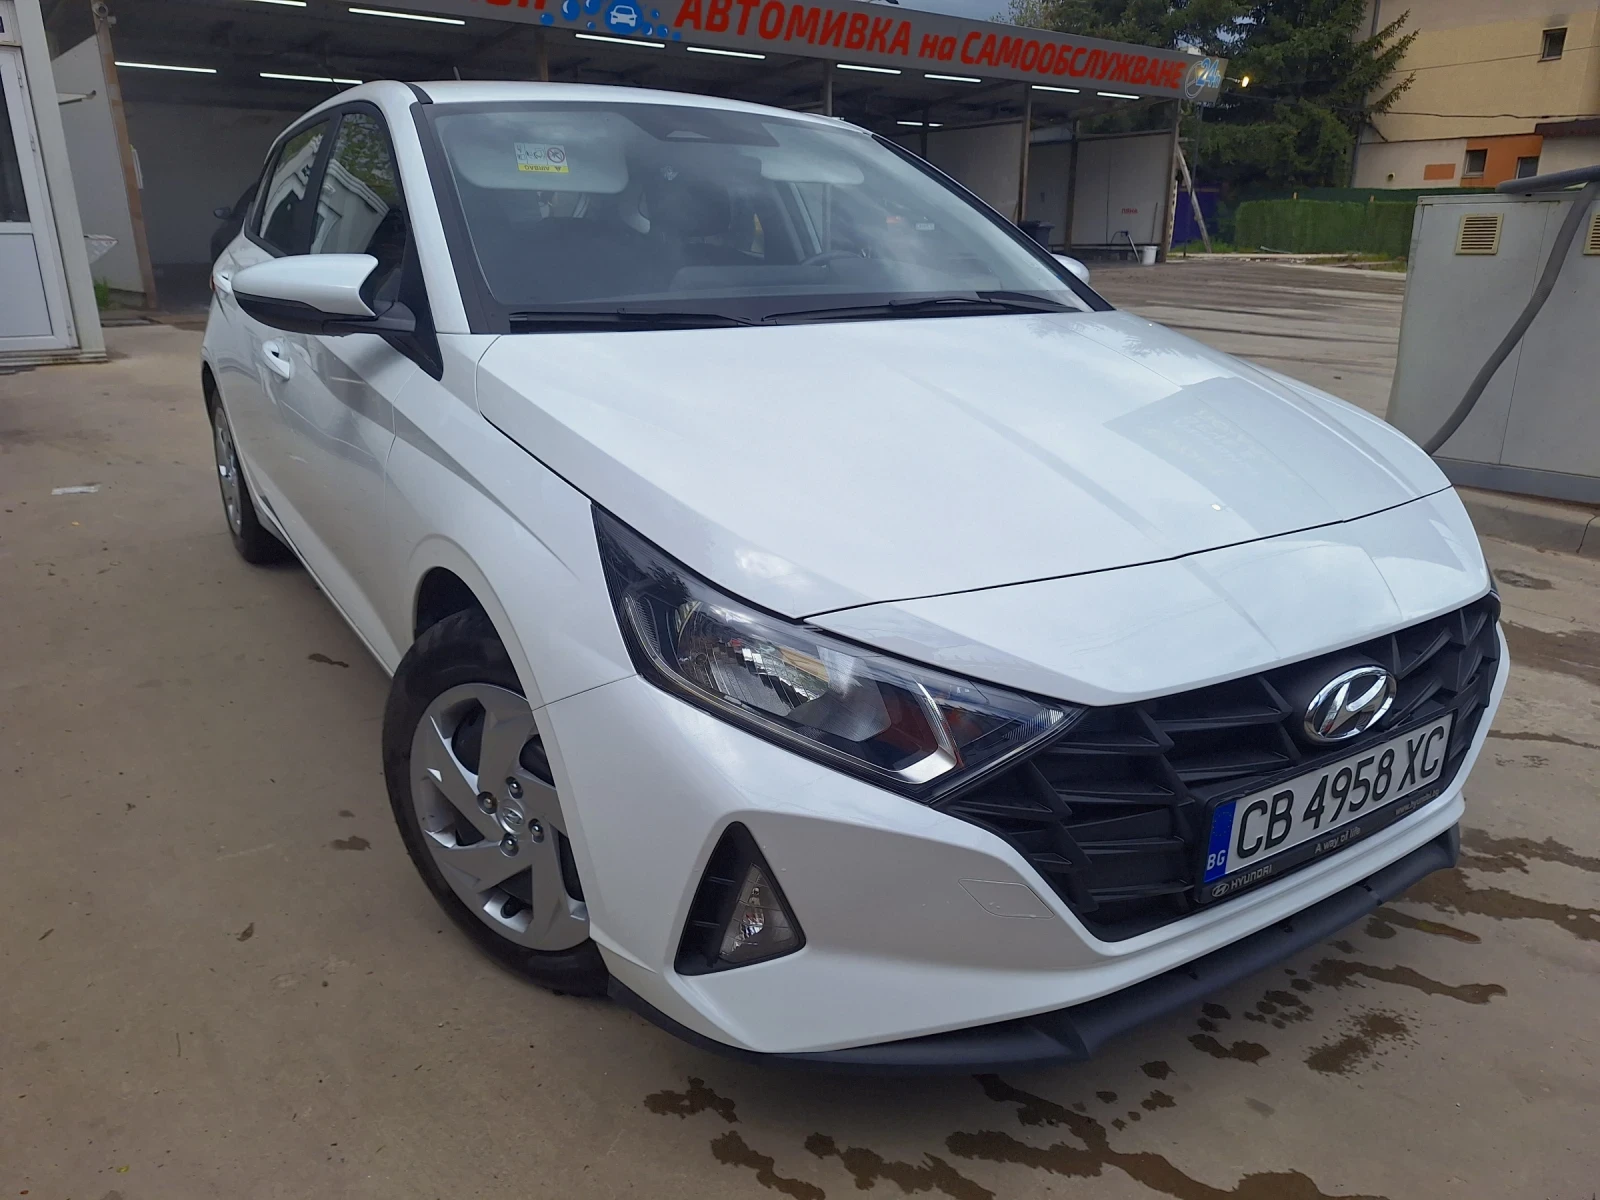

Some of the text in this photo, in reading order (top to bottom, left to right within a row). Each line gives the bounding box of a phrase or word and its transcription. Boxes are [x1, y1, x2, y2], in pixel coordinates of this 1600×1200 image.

[673, 0, 1188, 89] АВТОМИВКА на САМООБСЛУЖВАНЕ
[1236, 725, 1444, 859] CB 4958 XC
[1315, 826, 1361, 854] A way of life
[1206, 850, 1226, 871] BG
[1231, 864, 1272, 890] HYUNDAI
